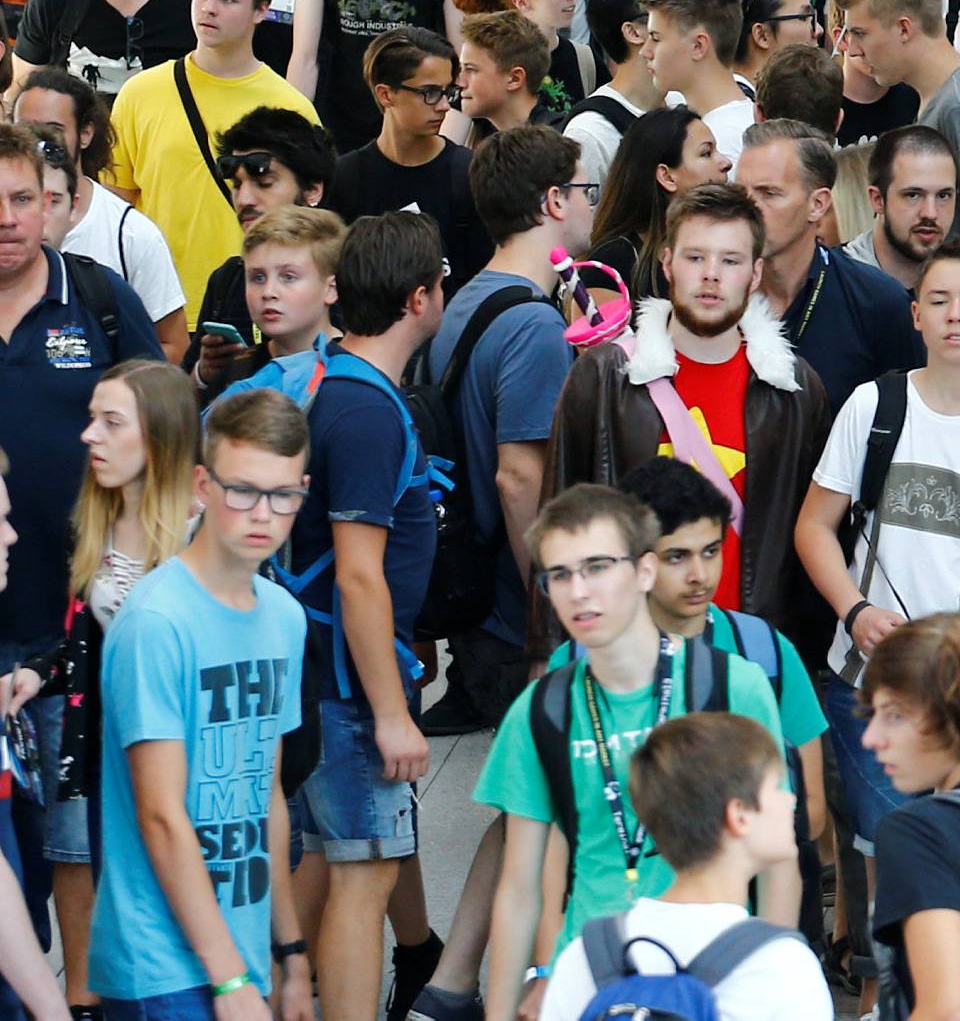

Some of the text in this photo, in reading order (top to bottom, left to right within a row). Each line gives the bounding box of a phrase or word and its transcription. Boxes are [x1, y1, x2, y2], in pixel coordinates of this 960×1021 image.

[200, 658, 289, 723] THE
[201, 717, 277, 778] ULT
[613, 810, 631, 854] Terminal
